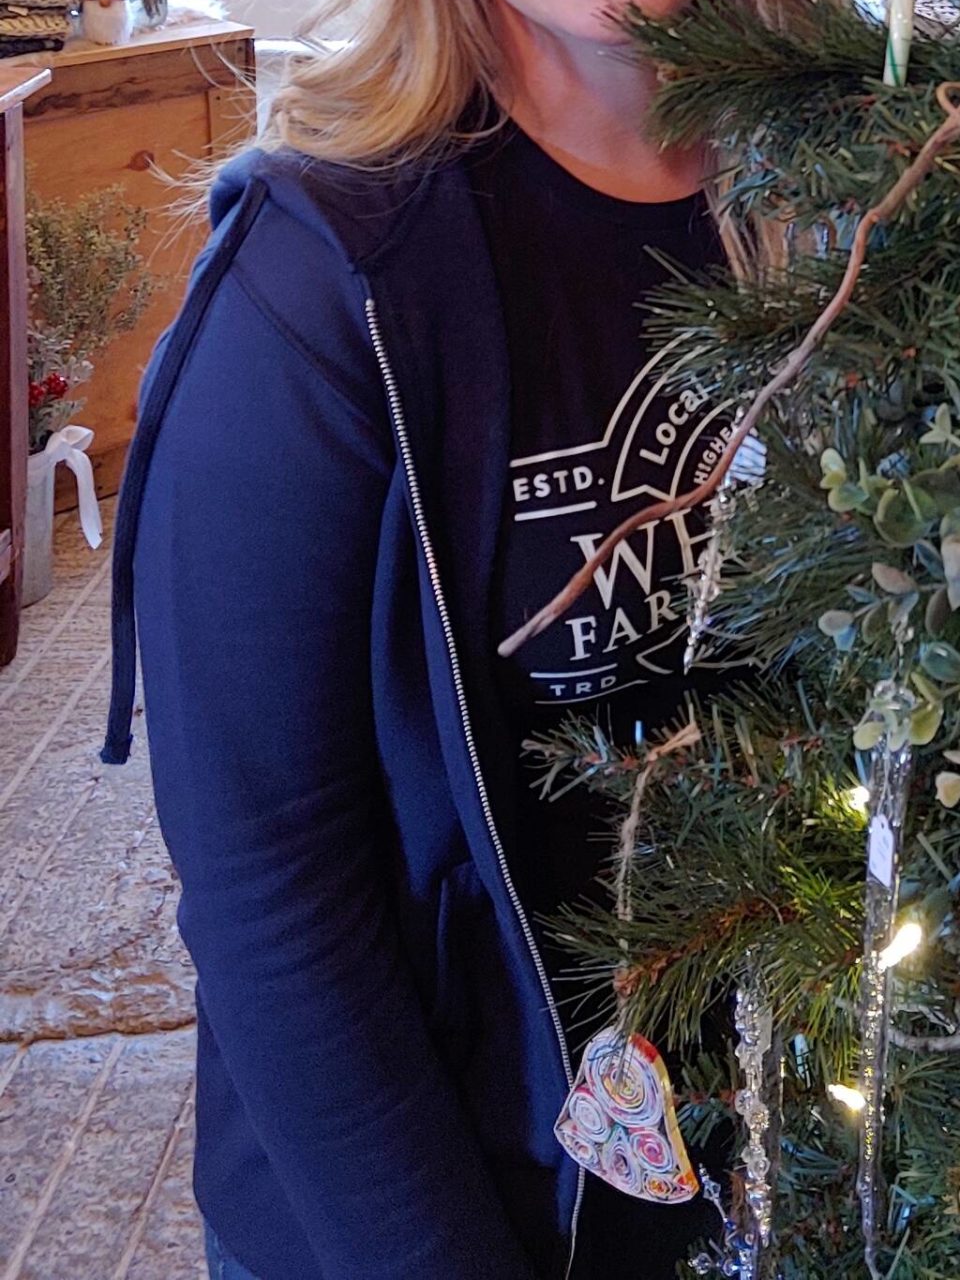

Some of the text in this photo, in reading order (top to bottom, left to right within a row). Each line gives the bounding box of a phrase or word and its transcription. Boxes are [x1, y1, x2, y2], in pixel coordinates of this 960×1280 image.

[512, 465, 605, 502] ESTD.
[693, 425, 736, 485] HIGHE
[570, 508, 716, 611] WH
